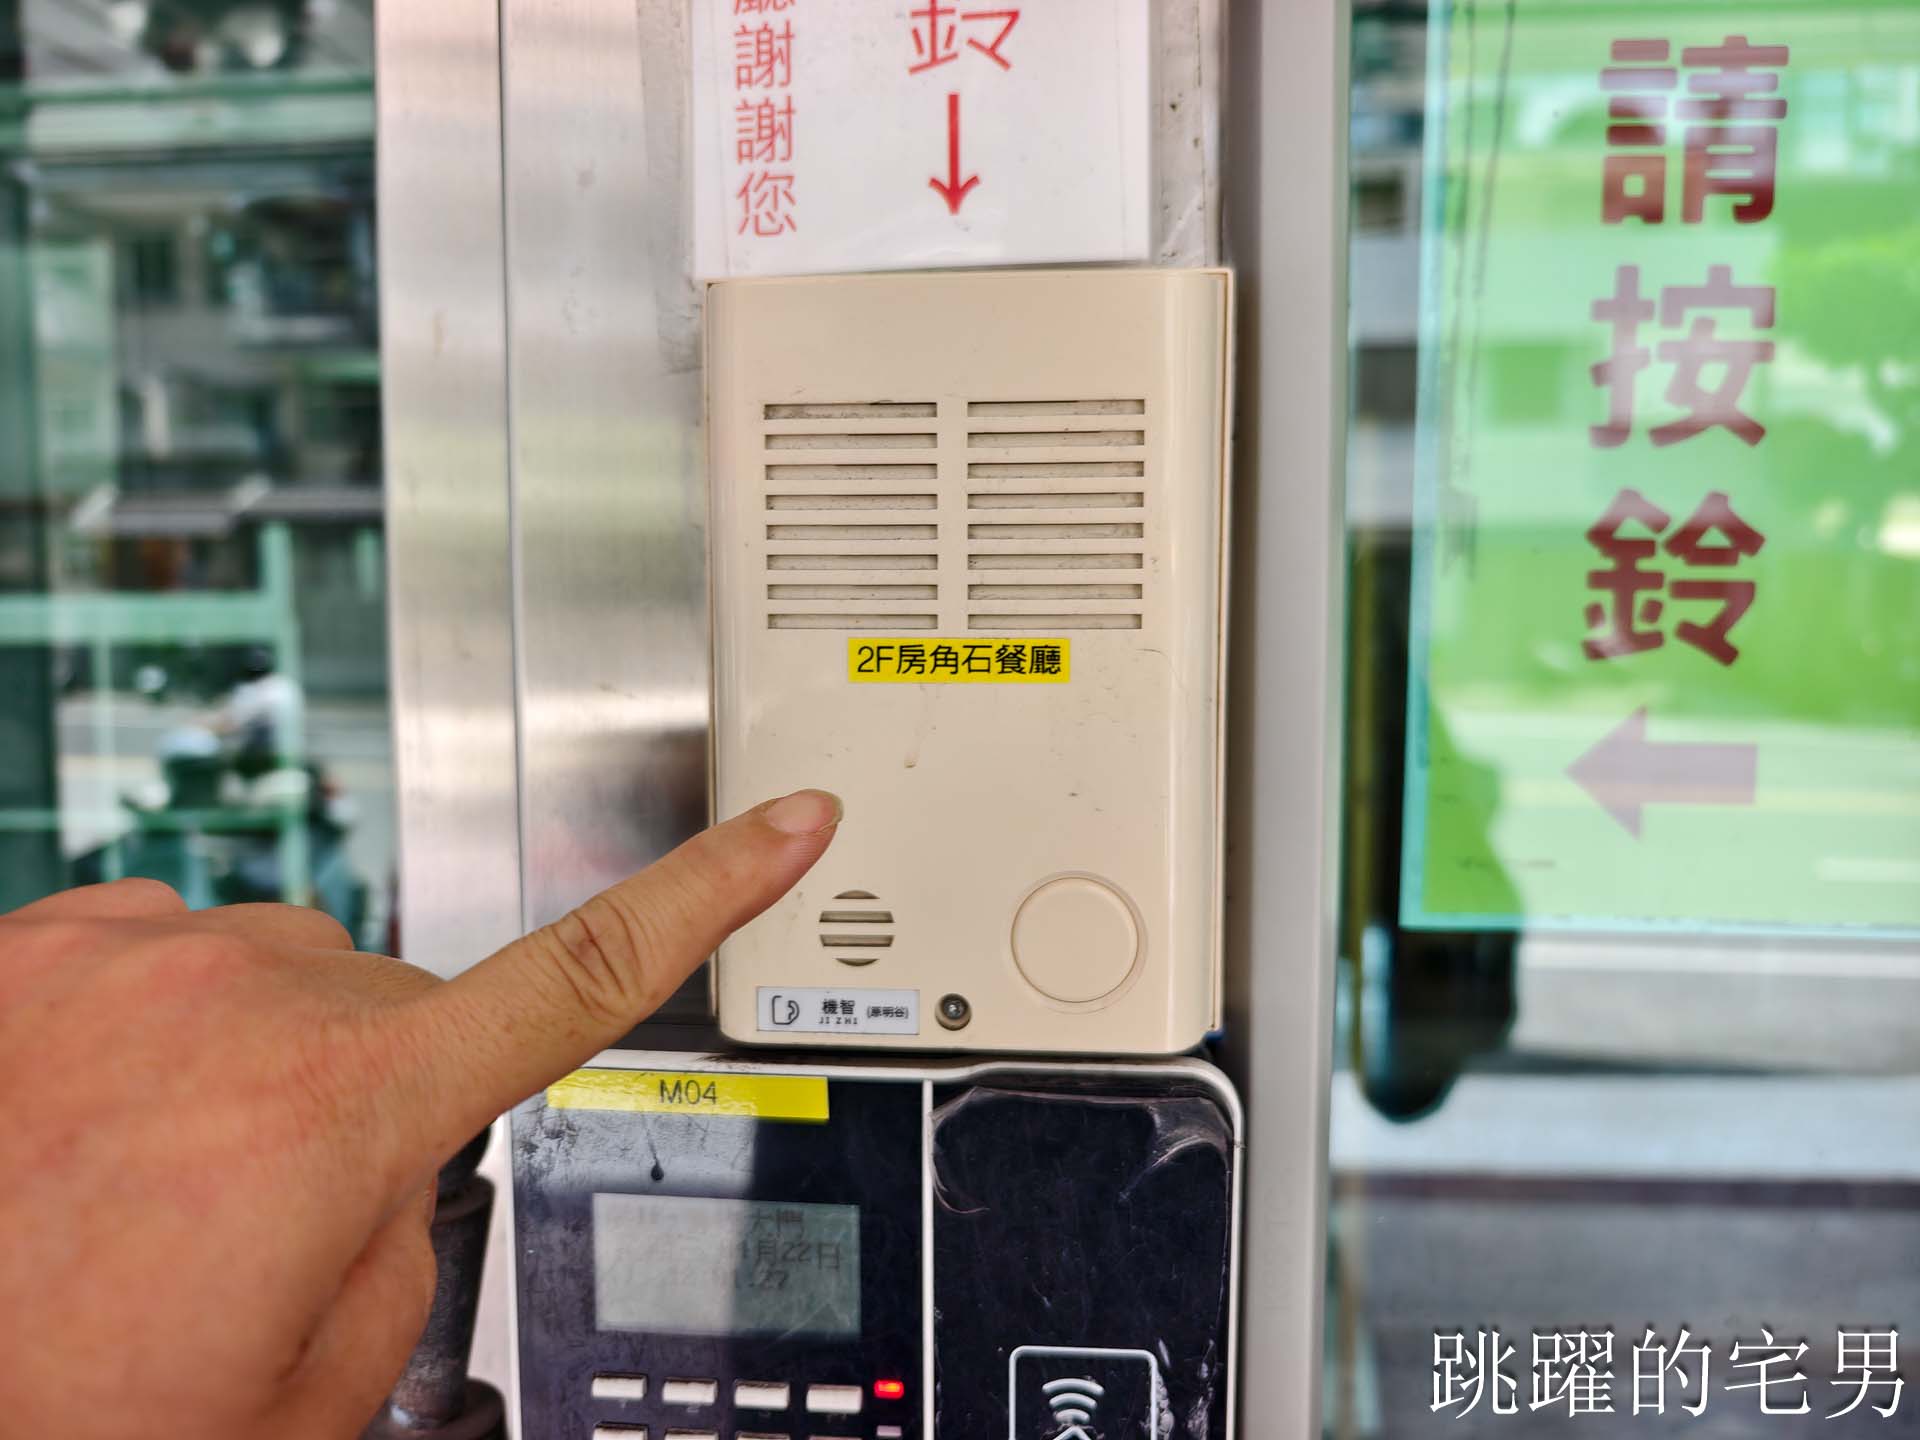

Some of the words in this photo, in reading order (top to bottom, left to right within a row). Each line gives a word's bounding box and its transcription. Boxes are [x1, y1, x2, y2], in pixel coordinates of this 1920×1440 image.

[733, 0, 798, 237] 謝謝您
[1582, 35, 1790, 667] 請按鈴
[857, 644, 1062, 675] 2F房角石餐廳
[659, 1079, 717, 1104] M04
